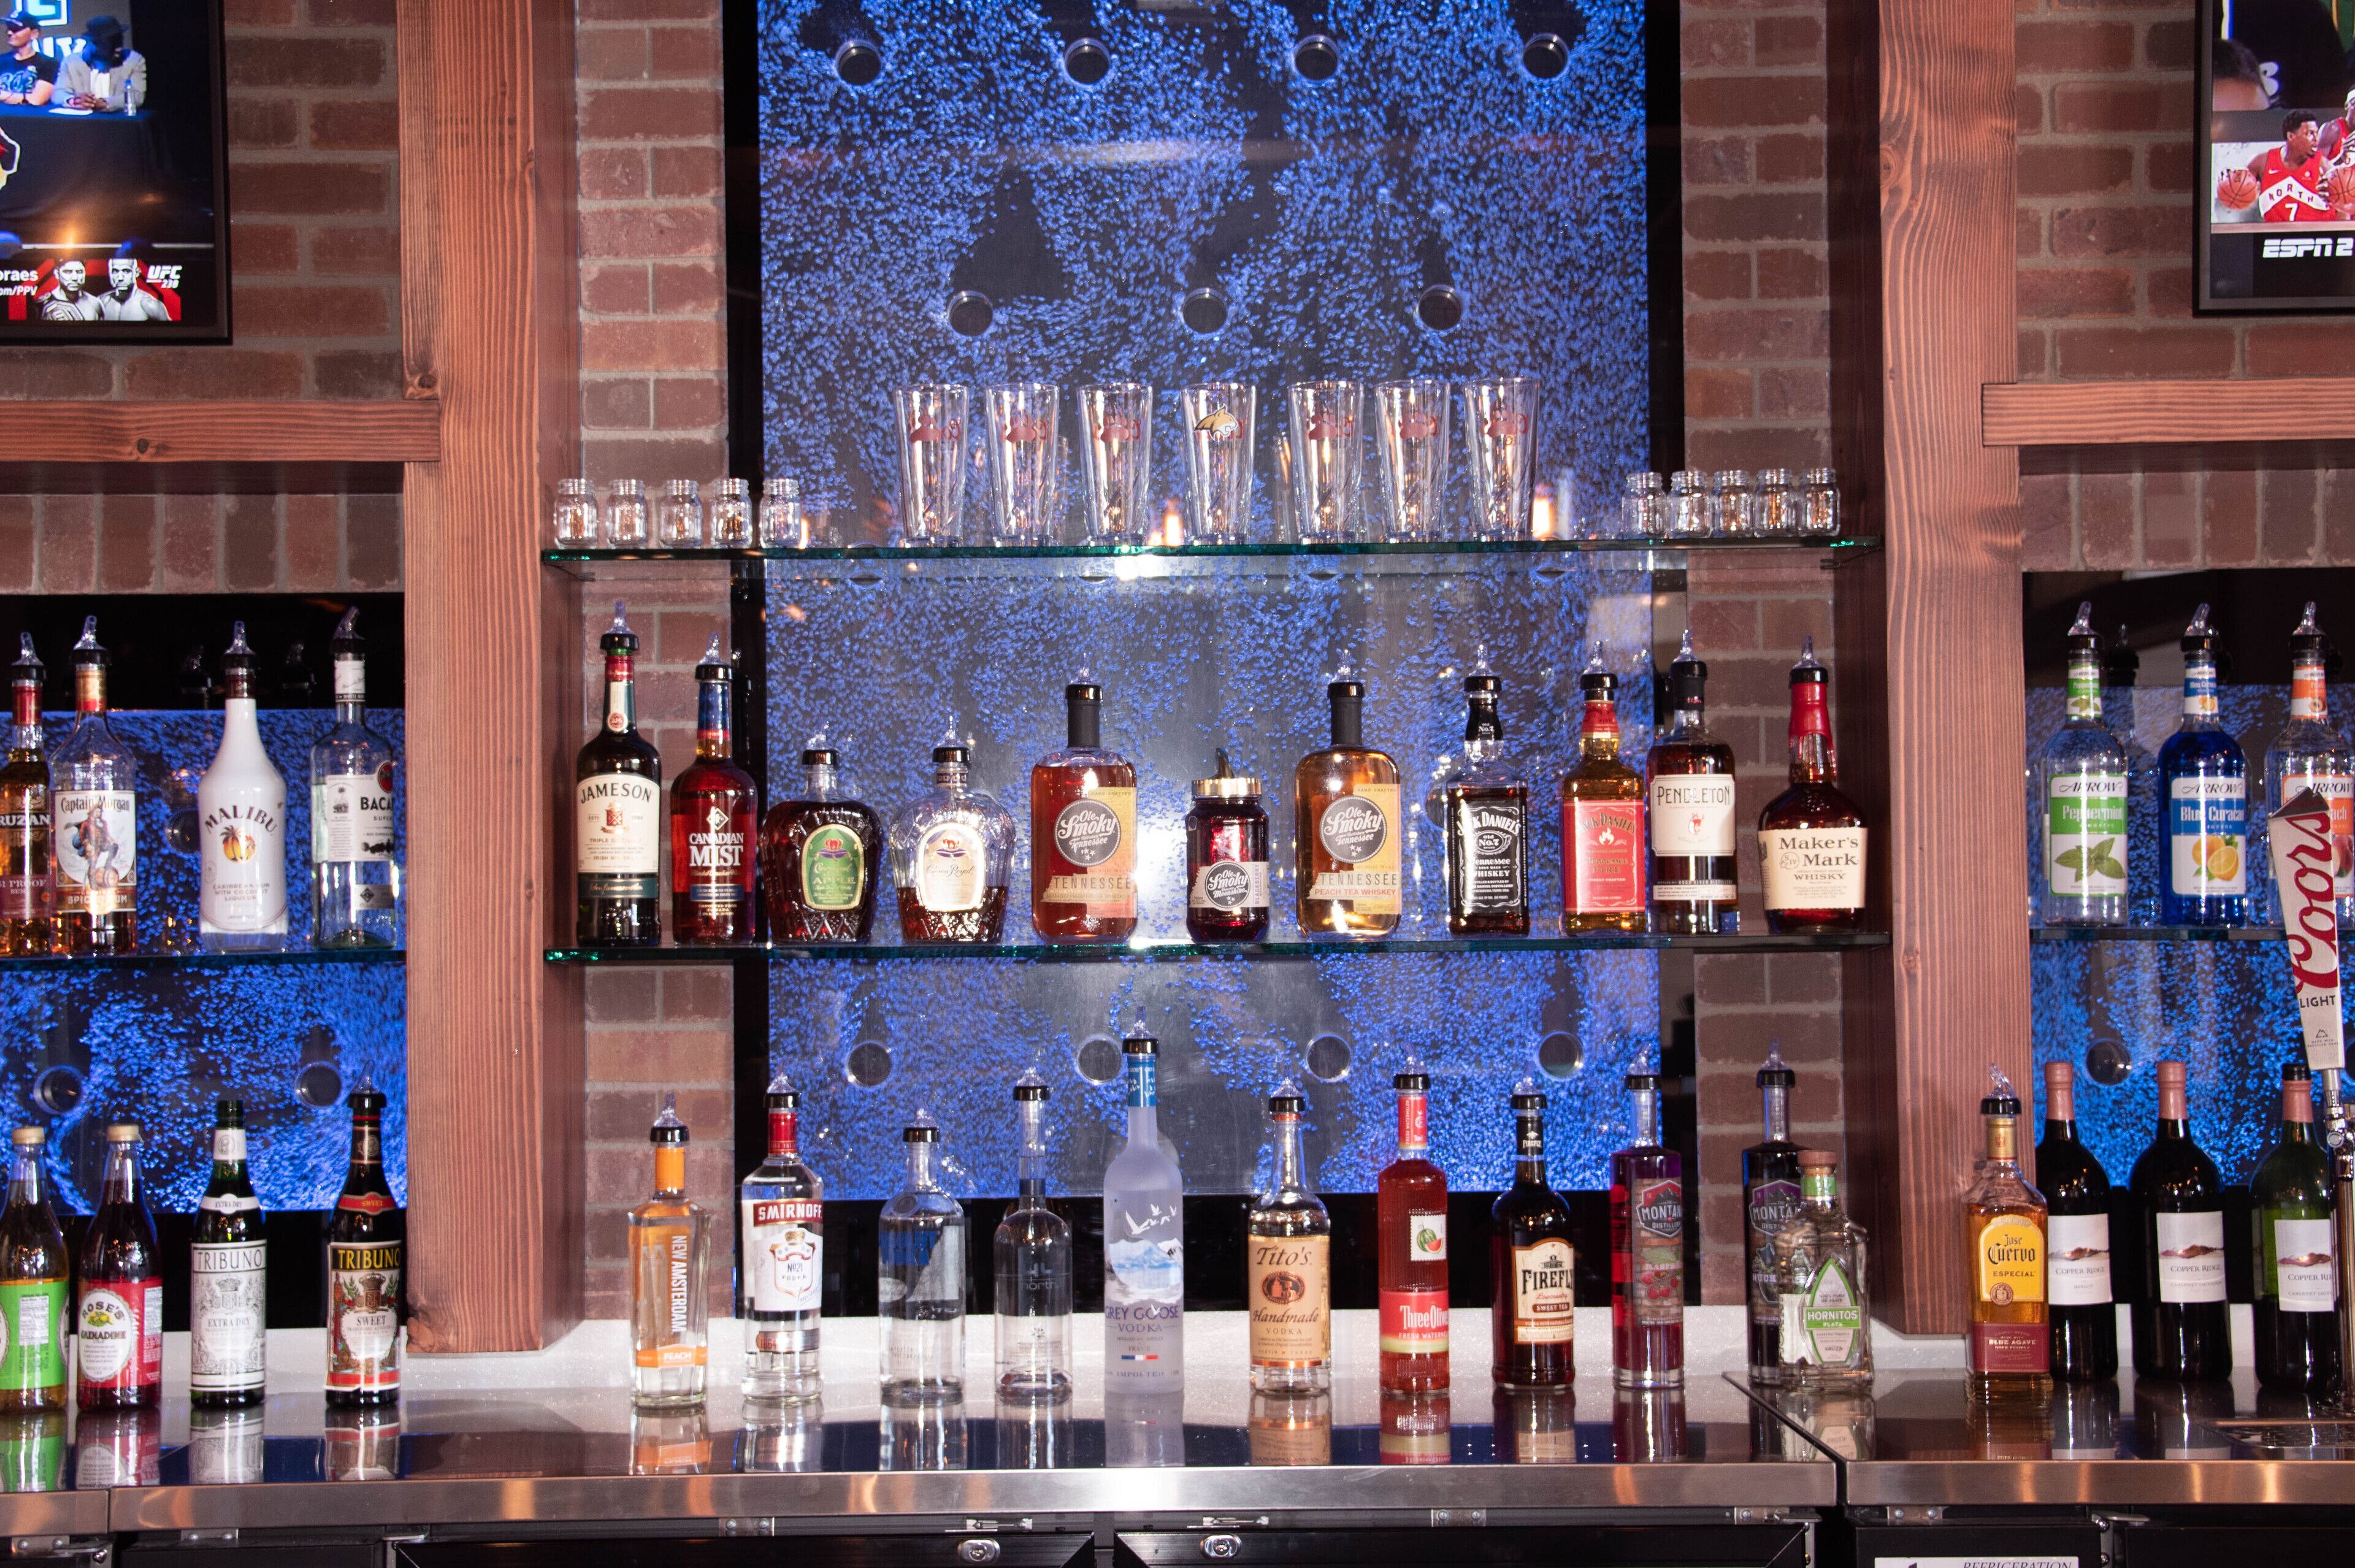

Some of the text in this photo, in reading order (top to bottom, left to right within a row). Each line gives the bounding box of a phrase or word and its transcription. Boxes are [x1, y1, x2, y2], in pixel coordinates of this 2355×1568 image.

[2269, 183, 2314, 201] NORTH
[2284, 202, 2299, 221] 7
[148, 266, 183, 280] UFC
[581, 782, 652, 804] JAMESON
[1656, 786, 1731, 806] PENDLETON
[2181, 782, 2243, 794] ARROW
[61, 795, 130, 813] Captain Morgan
[204, 805, 277, 834] MALIBU
[1079, 810, 1099, 822] Ole
[1346, 806, 1366, 819] Ole
[2062, 805, 2122, 821] Pepermint
[2181, 806, 2205, 822] Blu
[2330, 807, 2346, 820] ach
[1058, 813, 1118, 839] Smoky
[1324, 810, 1383, 836] Smoky
[1457, 811, 1522, 836] JK DANIEL'S
[689, 833, 744, 844] CANADIAN
[1069, 836, 1108, 854] Tennessee
[1335, 833, 1374, 846] Tennessee
[1779, 836, 1859, 850] Maker's
[689, 846, 744, 866] MIST
[1803, 853, 1858, 866] Mark
[1208, 871, 1248, 890] Smoky
[1222, 870, 1236, 879] Ole
[1320, 873, 1398, 885] TENNESSEE
[1054, 877, 1131, 889] TENNESSEE
[1213, 887, 1248, 898] Moonshine
[2284, 813, 2338, 993] Coors
[2300, 995, 2335, 1009] LIGHT
[758, 1203, 822, 1222] SMIRNOFF
[197, 1249, 262, 1270] TRIBUNO
[1257, 1245, 1312, 1266] Tito's
[1988, 1243, 2036, 1265] Cuervo
[2086, 1266, 2105, 1274] RIDGE
[671, 1235, 687, 1333] NEW AMSTERDAM
[82, 1301, 126, 1320] ROSE'S
[1106, 1305, 1178, 1320] GREY GOOSE
[1253, 1307, 1319, 1323] Handmade
[1400, 1304, 1449, 1329] Three Olive
[1807, 1310, 1858, 1320] HORNITOS
[207, 1318, 250, 1328] EXTRA DRY
[356, 1315, 386, 1326] SWEET
[1118, 1323, 1163, 1333] VODKA
[663, 1352, 692, 1361] PEACH
